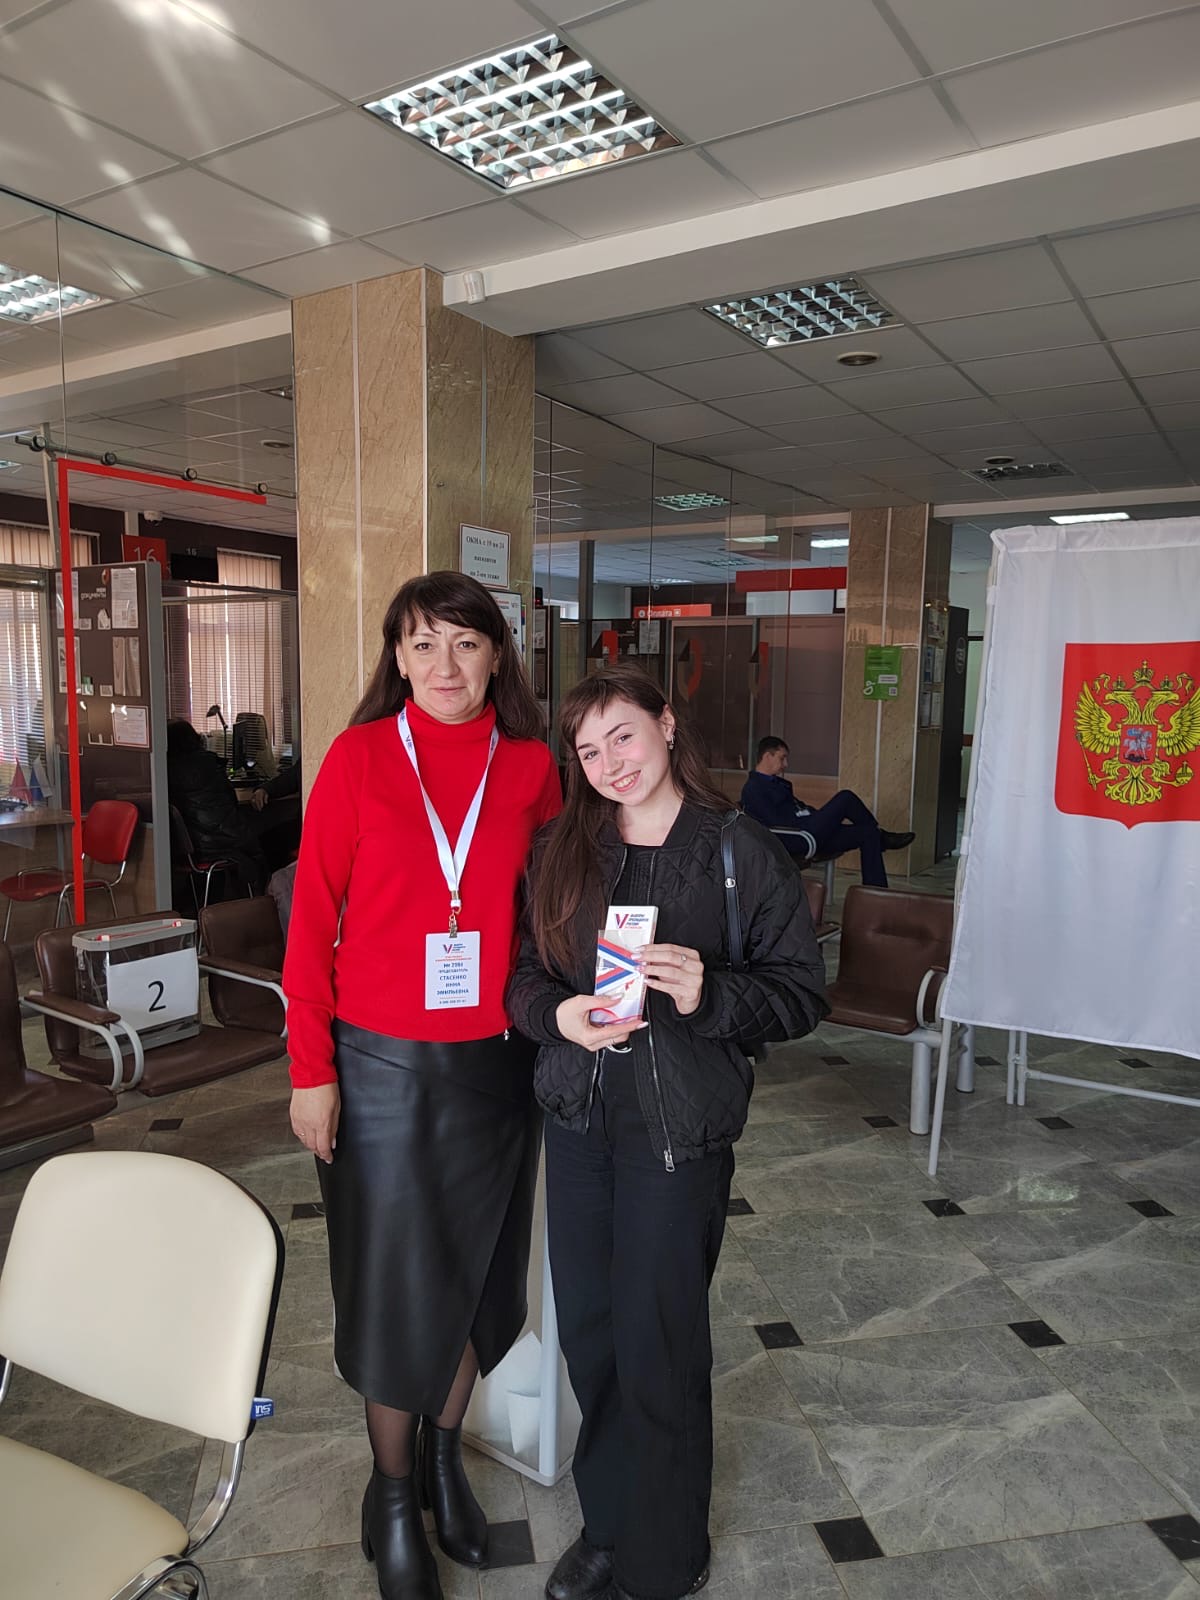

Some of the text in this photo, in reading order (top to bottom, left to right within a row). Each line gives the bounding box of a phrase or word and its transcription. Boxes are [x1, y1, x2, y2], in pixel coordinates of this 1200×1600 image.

[466, 535, 482, 545] ОКНА
[134, 546, 157, 562] 16
[148, 980, 167, 1013] 2
